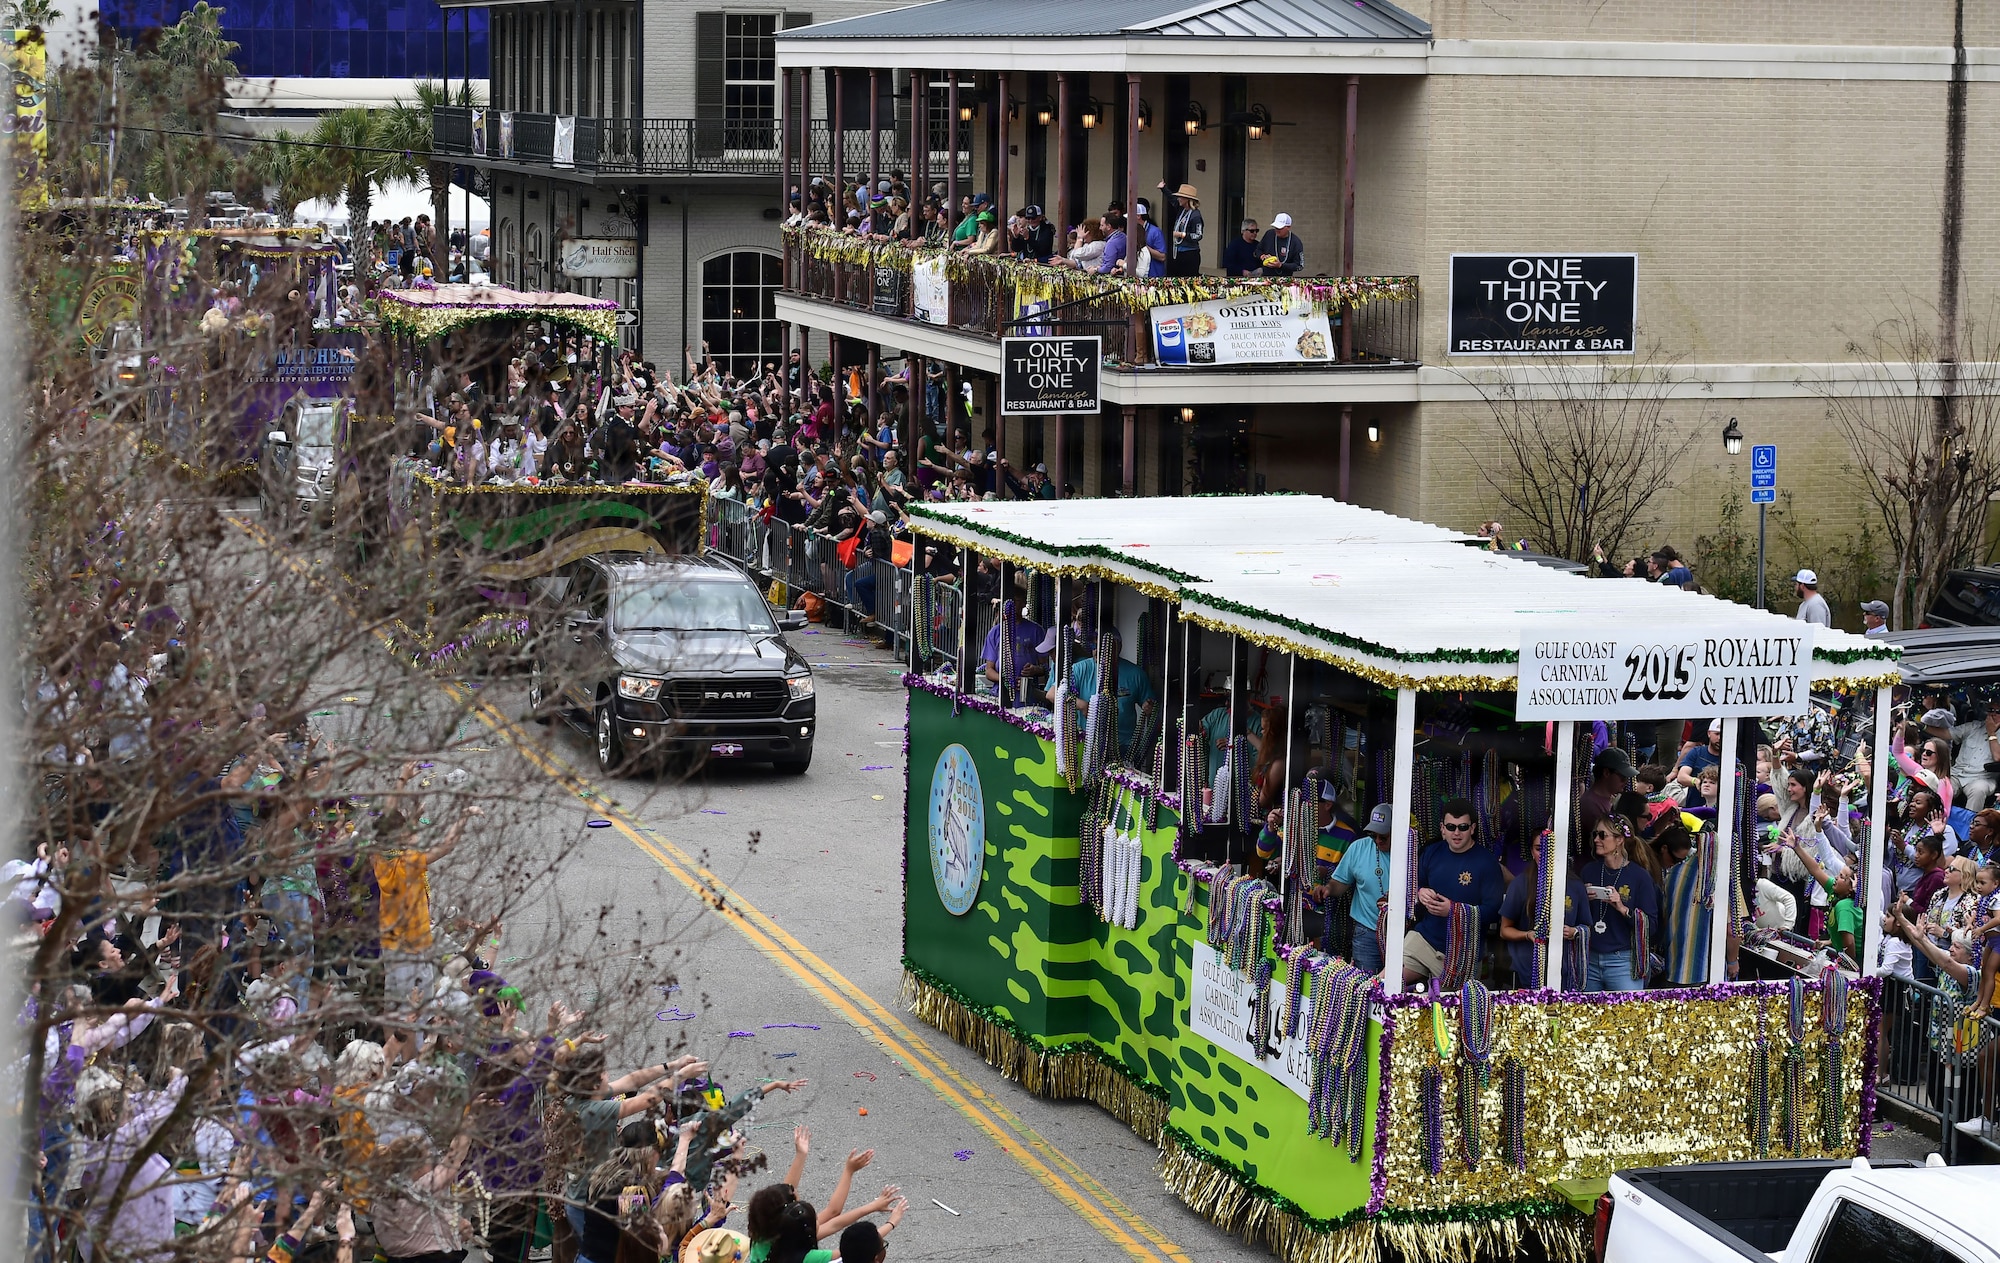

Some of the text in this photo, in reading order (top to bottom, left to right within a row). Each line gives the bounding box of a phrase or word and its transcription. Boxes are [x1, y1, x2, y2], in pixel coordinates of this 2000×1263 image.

[592, 246, 635, 256] Half Shell
[1507, 258, 1583, 280] ONE
[1479, 280, 1608, 301] THIRTY
[1219, 304, 1289, 318] OYSTERS
[1505, 301, 1581, 323] ONE
[1230, 320, 1282, 329] THREE WAYS
[1223, 331, 1291, 341] GARLIC PARMESAN
[1231, 340, 1286, 349] BACON GOUDA
[1458, 338, 1625, 351] RESTAURANT & BAR
[1029, 342, 1074, 358] ONE
[1194, 342, 1210, 350] ONE
[1235, 349, 1284, 358] ROCKEFELLER
[1013, 357, 1089, 374] THIRTY
[1028, 373, 1074, 389] ONE
[1006, 399, 1096, 410] RESTAURANT & BAR
[1535, 641, 1618, 659] GULF COAST
[1702, 637, 1802, 668] ROYALTY
[1540, 664, 1608, 682] CARNIVAL
[1622, 643, 1698, 701] 2015
[704, 691, 752, 699] RAM
[1529, 688, 1618, 706] ASSOCIATION
[1700, 675, 1799, 706] & FAMILY
[956, 778, 979, 805] GCCA
[957, 797, 977, 821] 2015
[1202, 960, 1245, 998] GULF COAST
[1204, 984, 1240, 1018] CARNIVAL
[1198, 1007, 1245, 1046] ASSOCIATION
[1246, 988, 1287, 1060] 215
[1286, 1044, 1296, 1077] &
